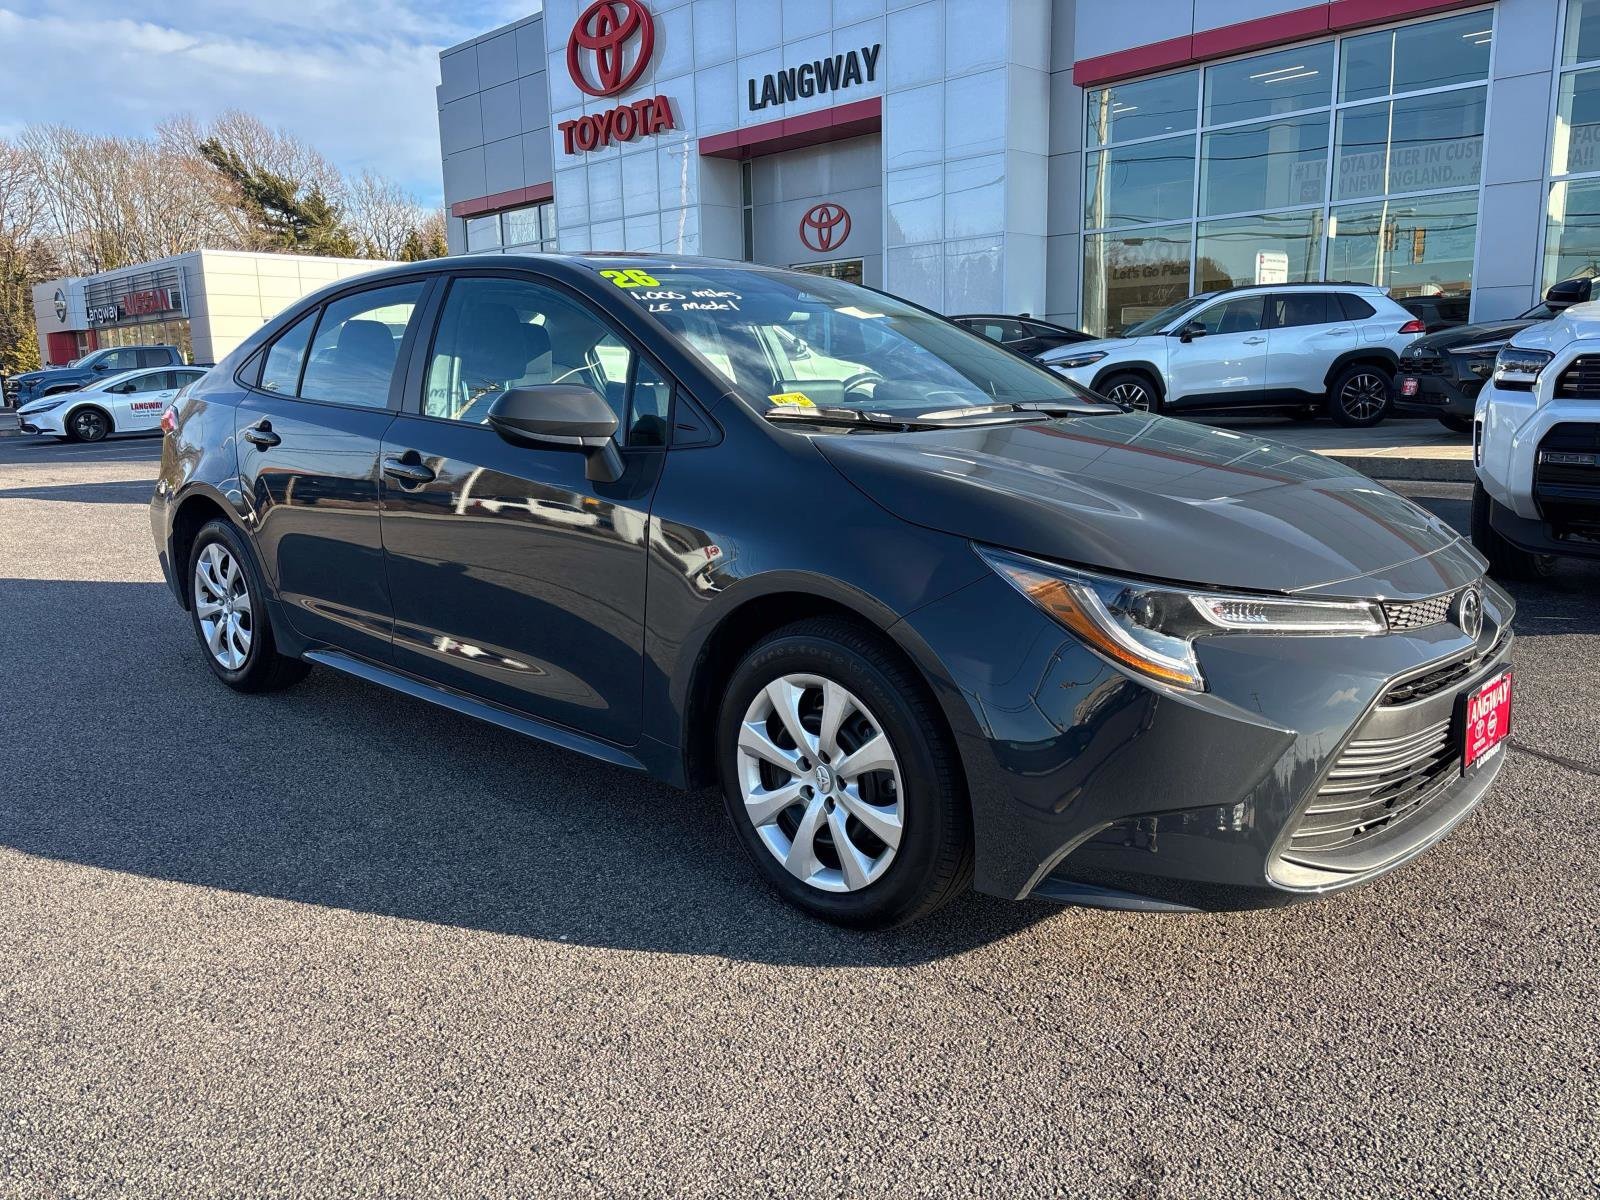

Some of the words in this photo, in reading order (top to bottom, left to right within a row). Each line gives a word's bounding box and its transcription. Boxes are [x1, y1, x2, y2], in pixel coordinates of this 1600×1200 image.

[748, 44, 880, 111] LANGWAY
[558, 95, 675, 155] TOYOTA
[1425, 146, 1442, 163] IN
[1349, 173, 1379, 193] NEW
[1389, 166, 1464, 188] NGLAND...
[599, 268, 661, 288] 26
[1113, 265, 1139, 280] Let's
[1143, 265, 1159, 278] Go
[87, 304, 120, 323] Langway
[123, 289, 172, 316] NISSAN
[648, 303, 672, 312] LE
[130, 402, 162, 410] LANGWAY
[1467, 681, 1510, 730] LANGWAY
